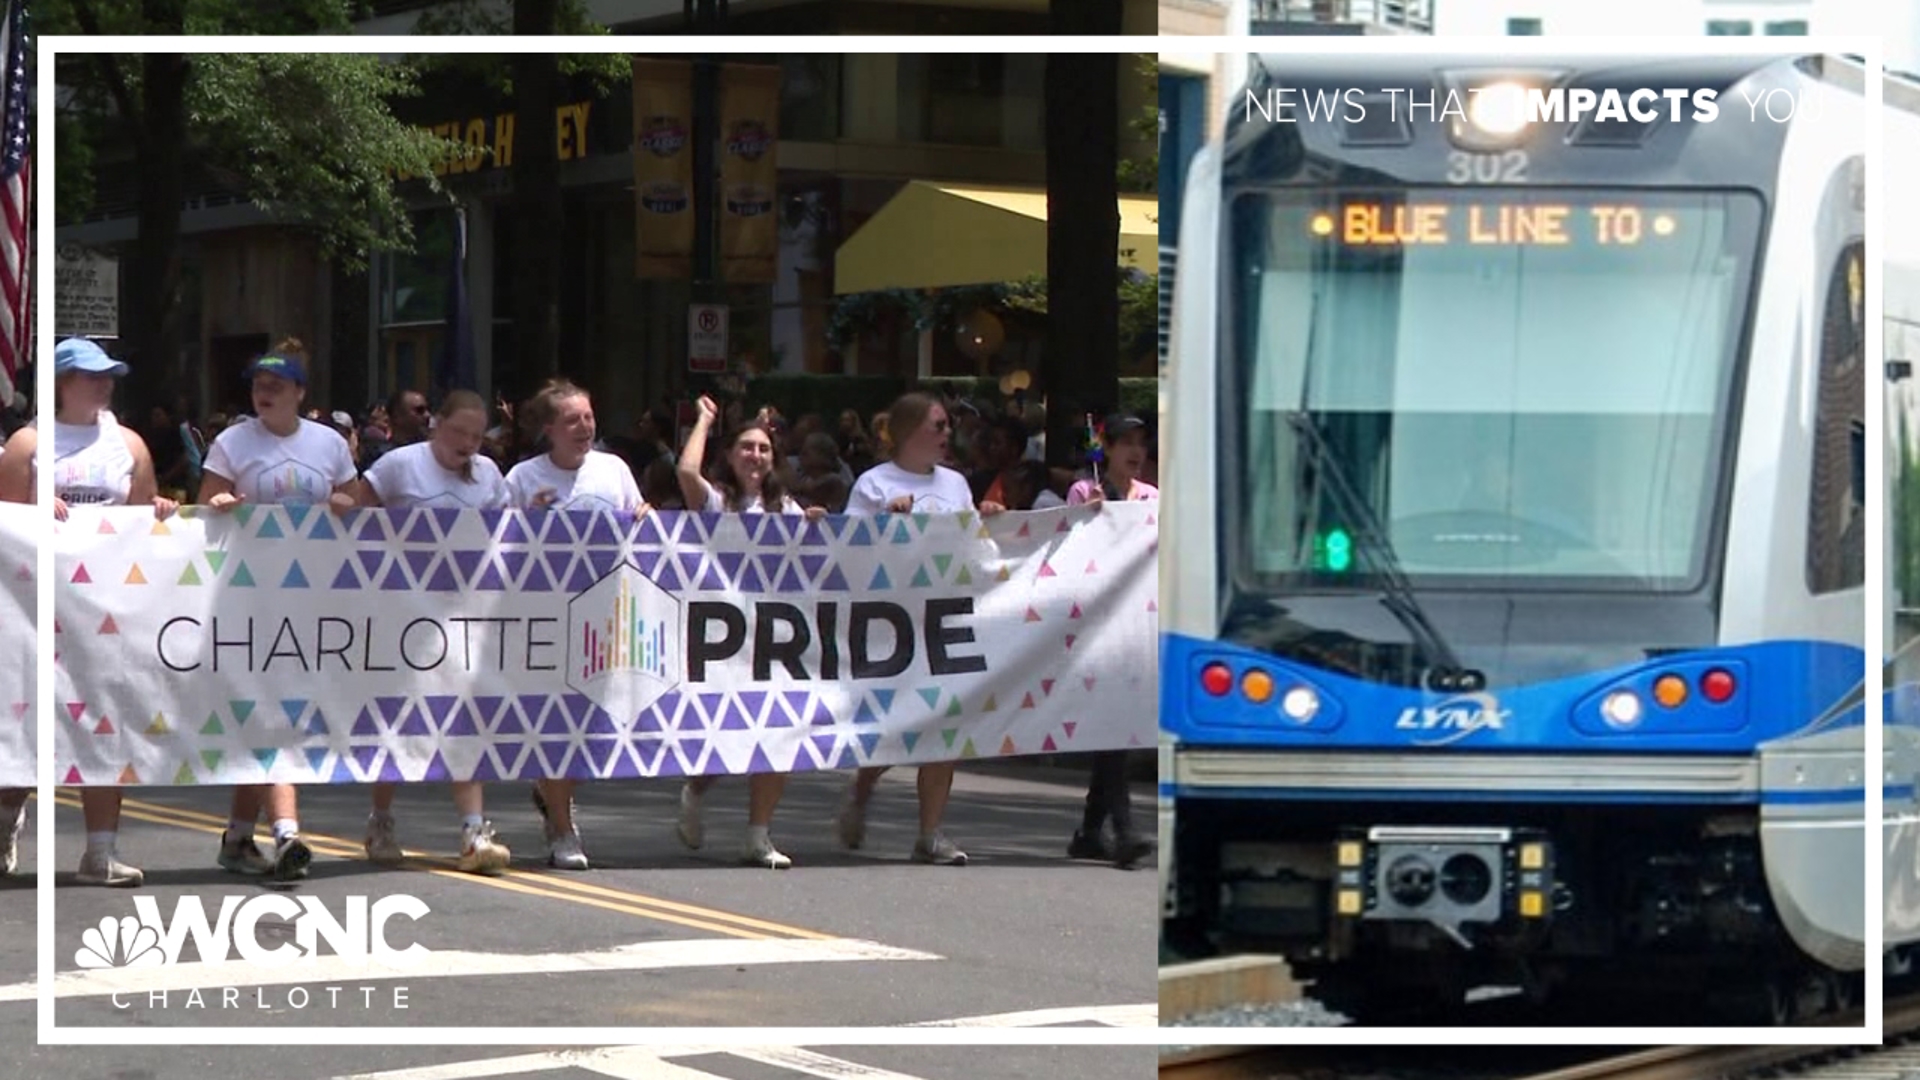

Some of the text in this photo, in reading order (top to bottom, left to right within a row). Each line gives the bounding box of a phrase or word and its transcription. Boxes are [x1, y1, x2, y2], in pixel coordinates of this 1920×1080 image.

[493, 102, 592, 168] HEY
[1447, 152, 1527, 184] 302
[1344, 205, 1641, 245] BLUE LINE TO
[156, 596, 987, 683] CHARLOTTE PRIDE
[1395, 707, 1513, 730] LYNX
